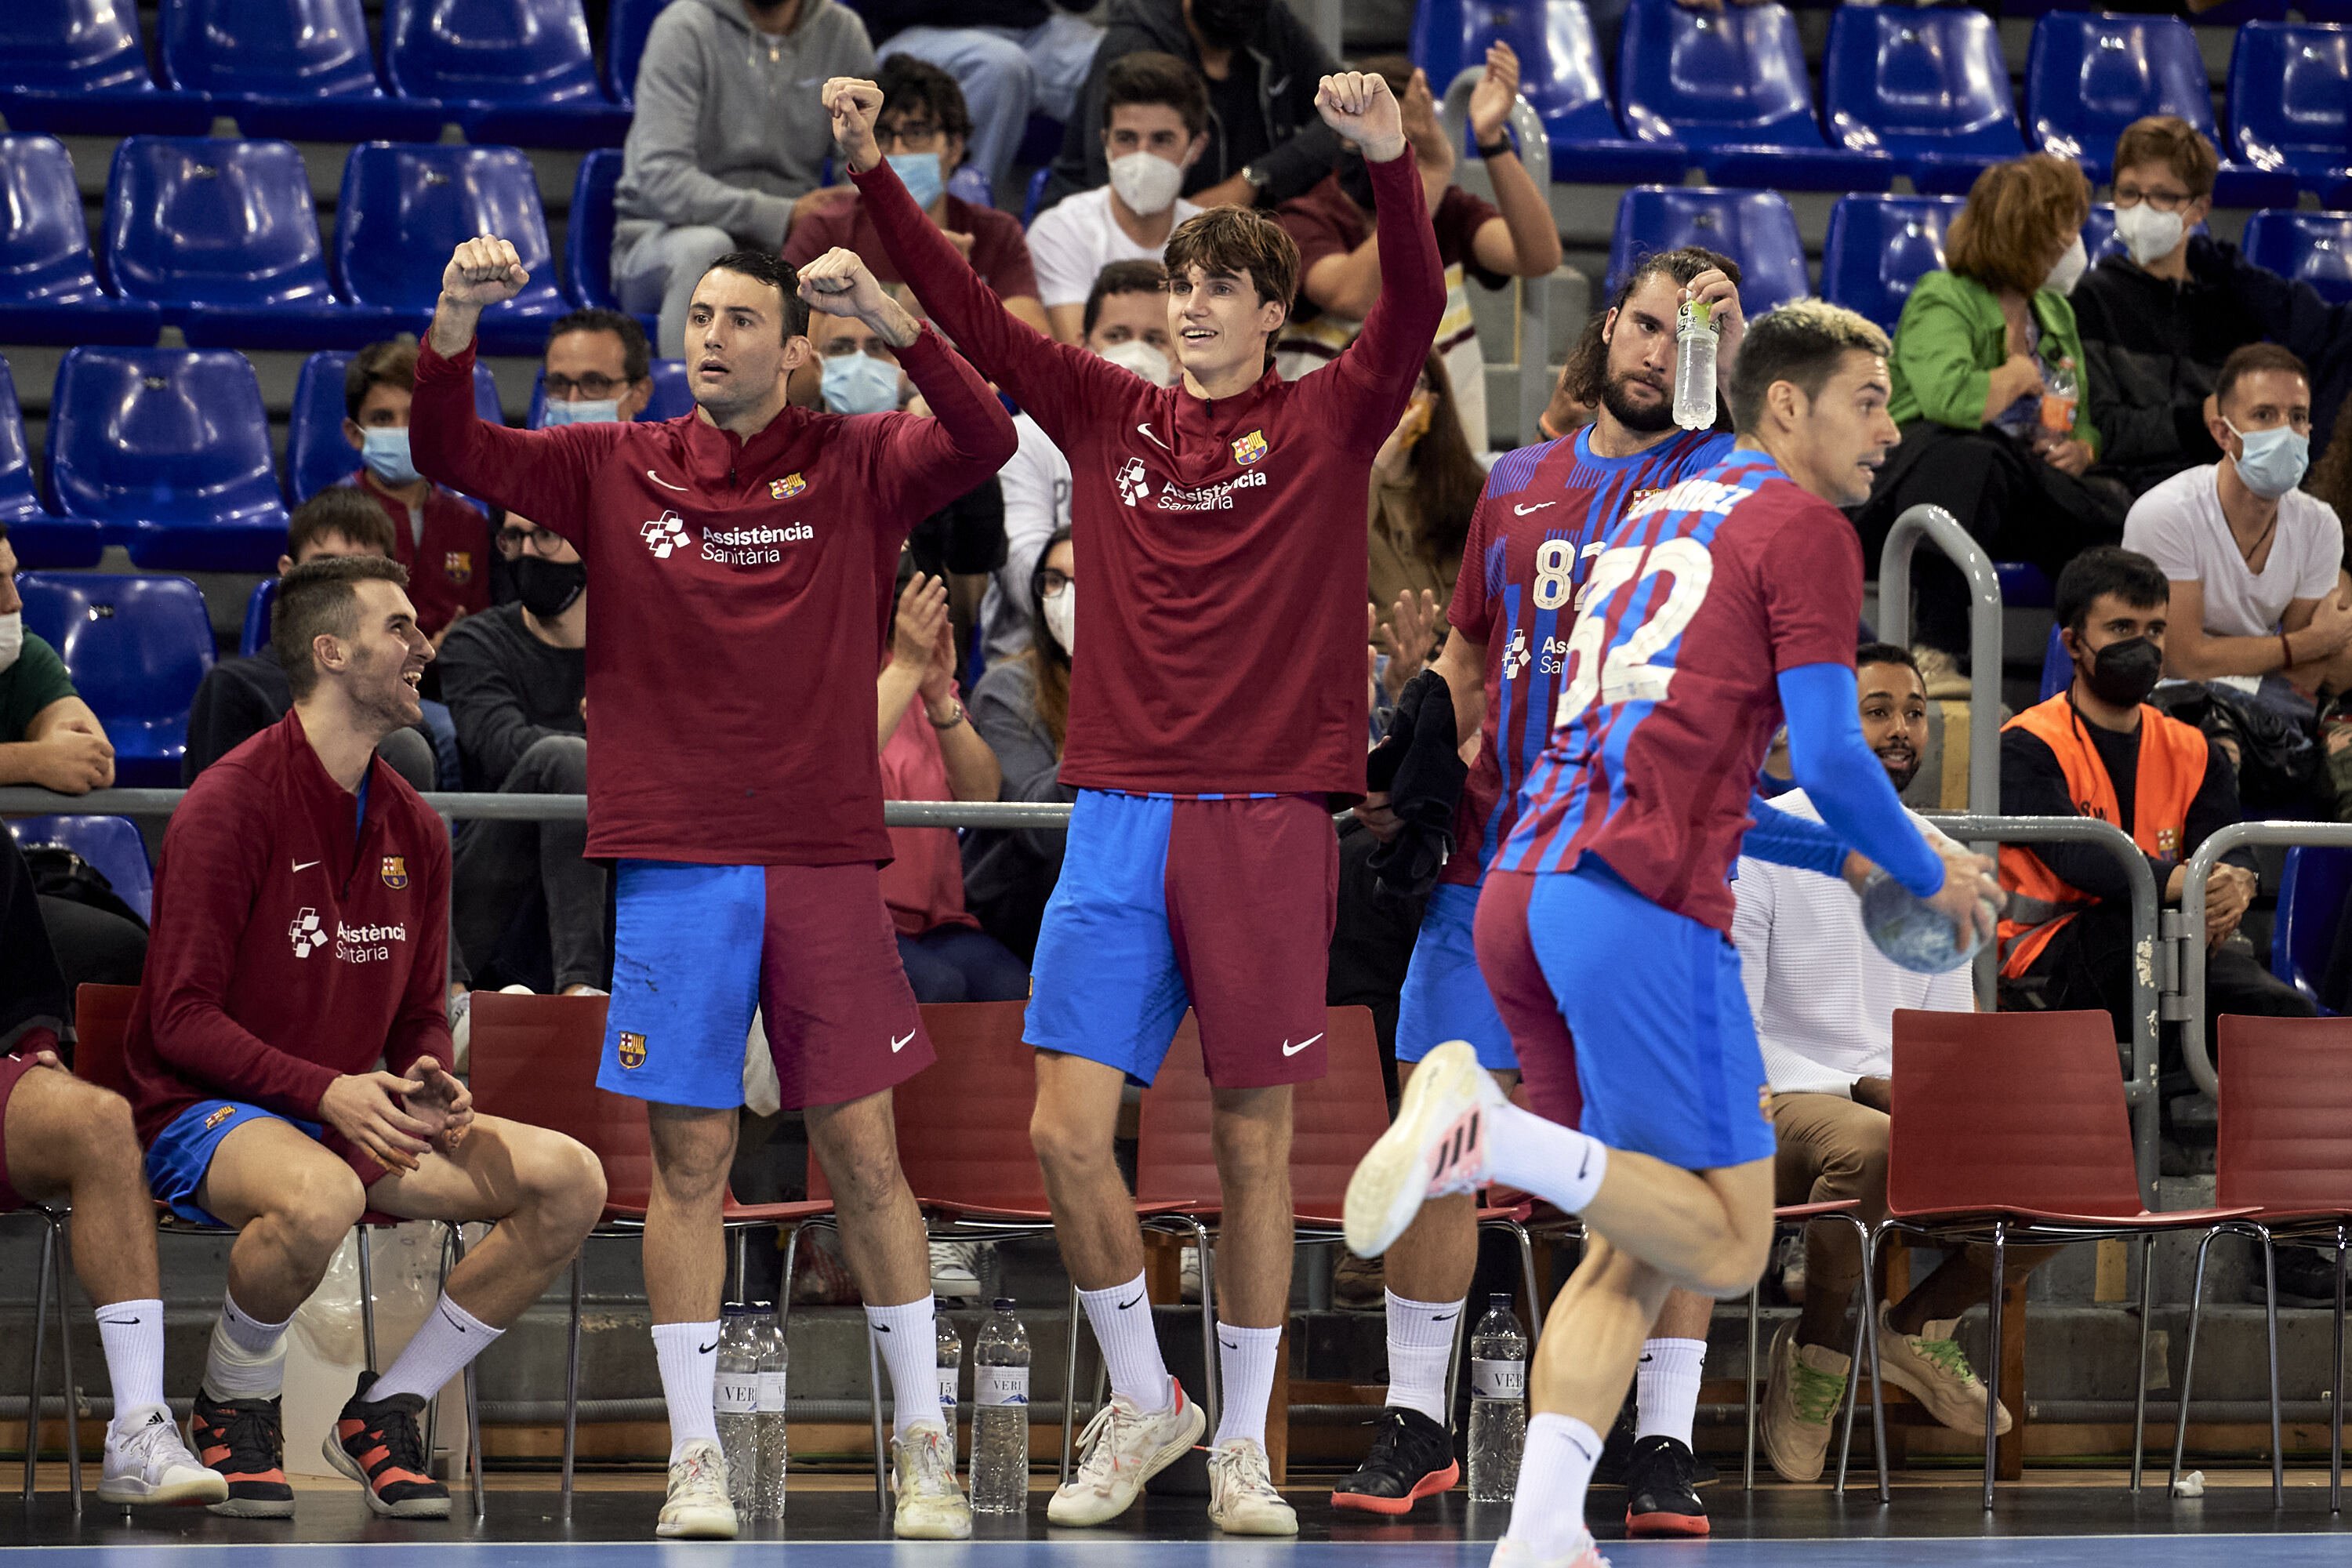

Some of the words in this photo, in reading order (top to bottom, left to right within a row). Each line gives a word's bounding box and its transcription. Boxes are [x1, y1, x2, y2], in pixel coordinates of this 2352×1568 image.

[702, 521, 814, 546] Assistència
[701, 543, 780, 565] Sanitària
[1554, 537, 1714, 730] 32
[993, 1380, 1022, 1391] VERI
[1495, 1373, 1523, 1387] VER
